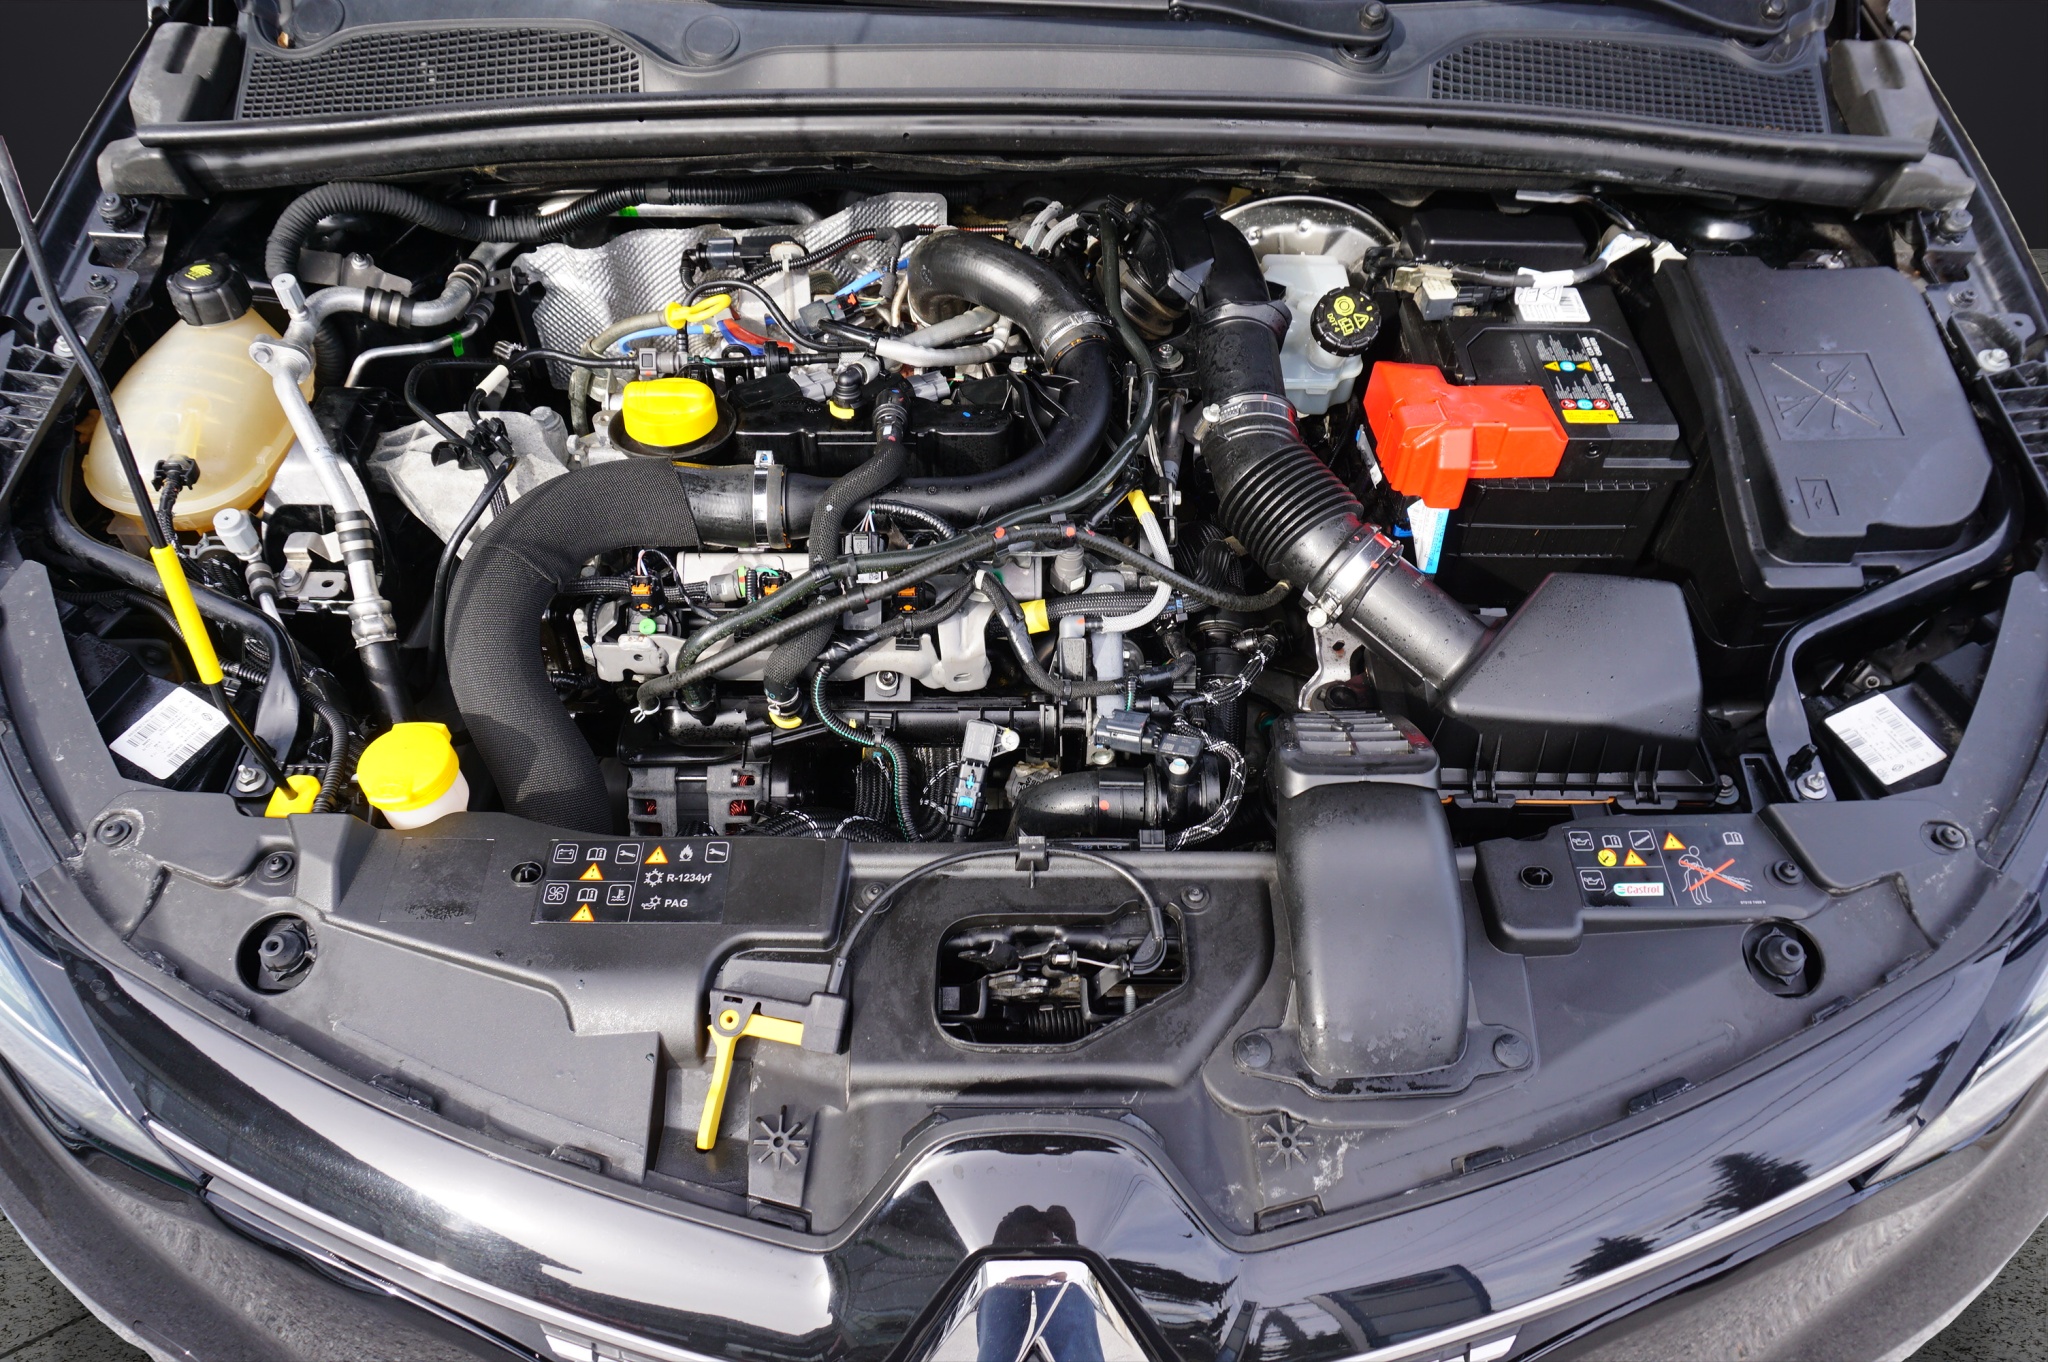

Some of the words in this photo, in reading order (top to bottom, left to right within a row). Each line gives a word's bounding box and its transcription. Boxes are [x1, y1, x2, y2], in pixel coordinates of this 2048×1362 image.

[1327, 312, 1338, 326] DOT
[666, 873, 712, 884] R-1234yf
[1626, 885, 1660, 894] Castrol
[664, 899, 688, 908] PAG
